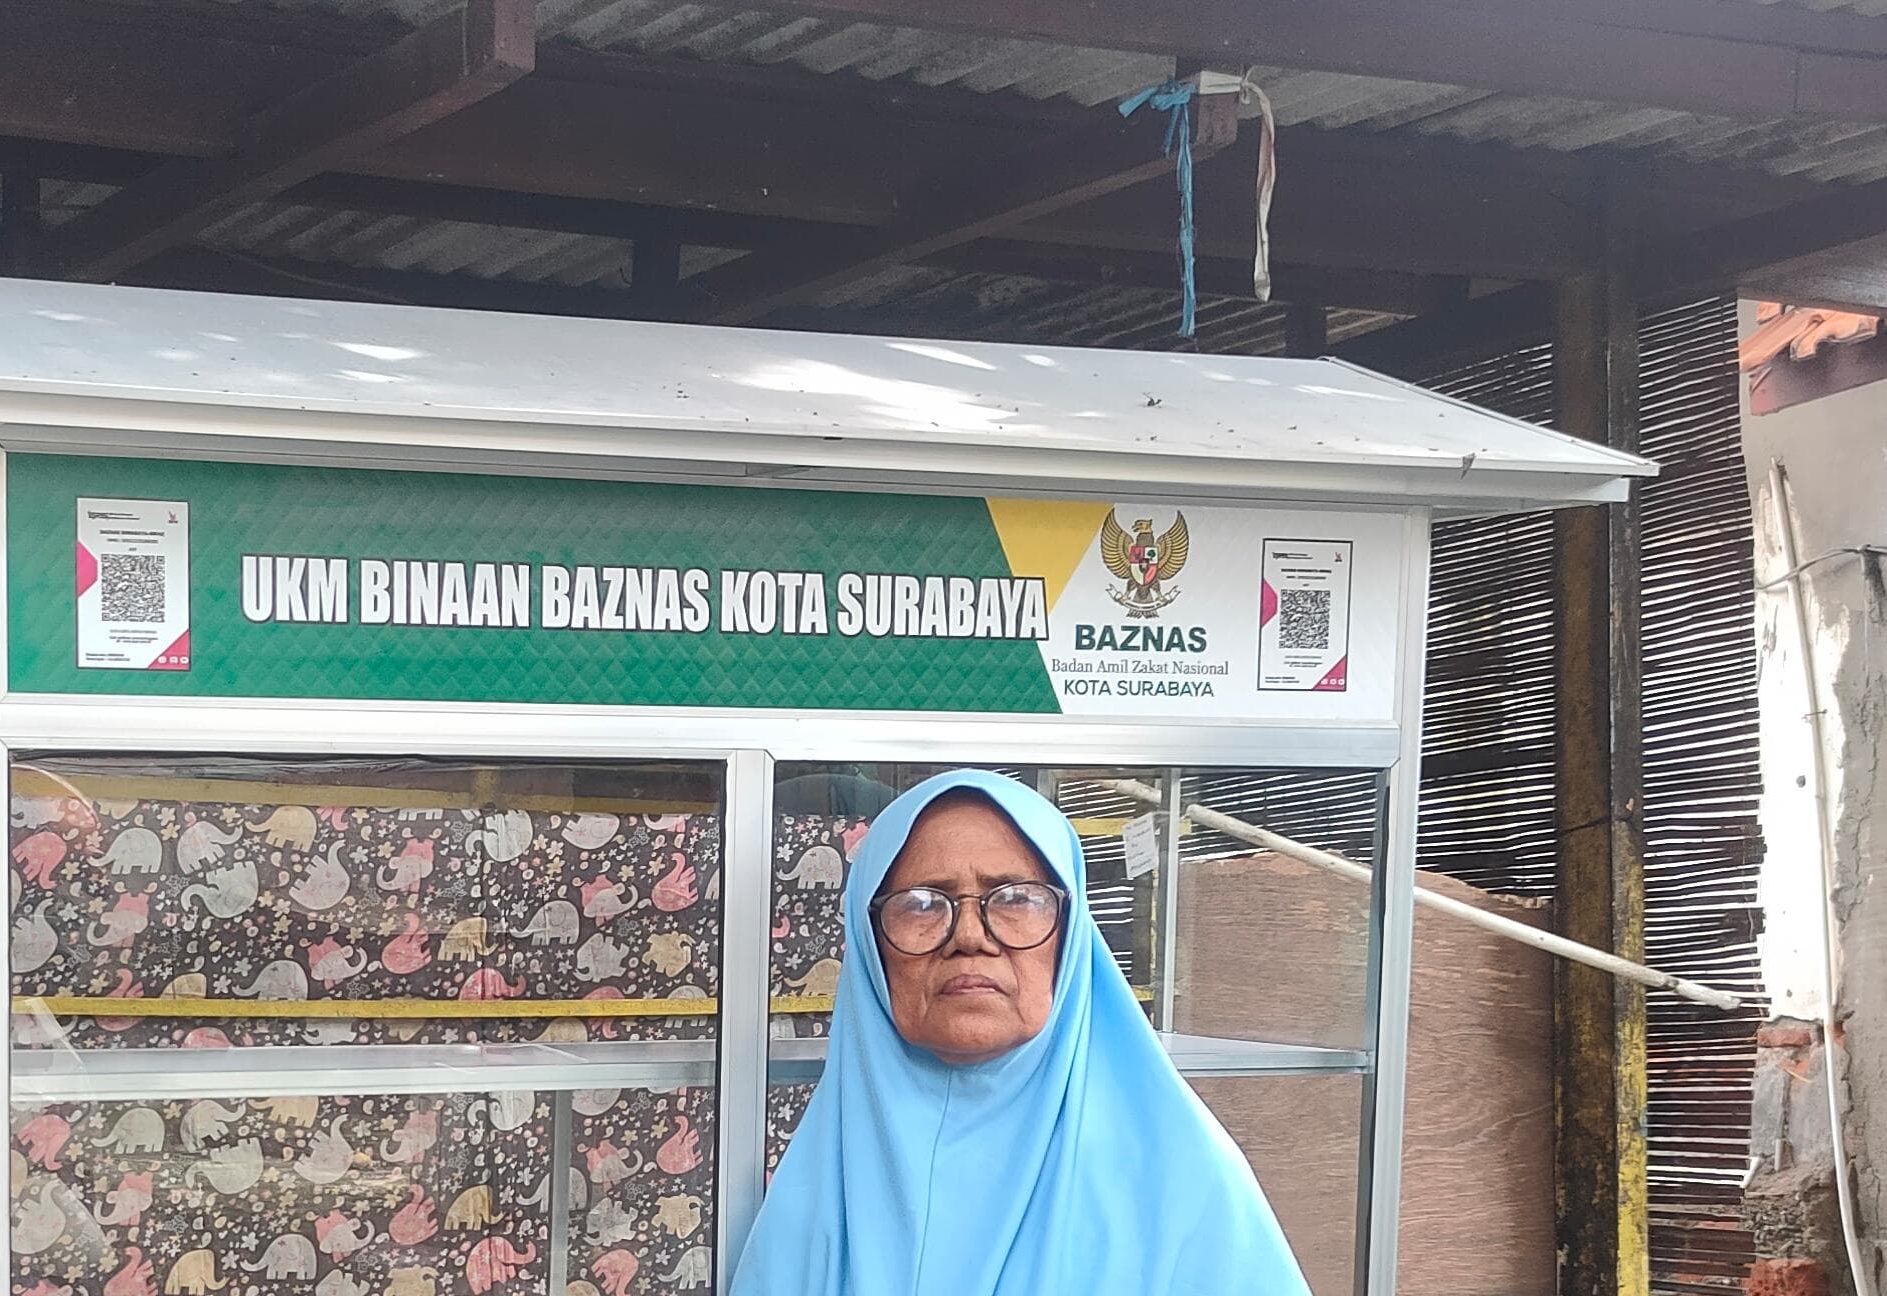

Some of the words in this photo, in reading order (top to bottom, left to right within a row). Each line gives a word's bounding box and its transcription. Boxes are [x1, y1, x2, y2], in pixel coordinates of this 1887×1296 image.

[240, 554, 349, 624] UKM
[360, 558, 531, 628] BINAAN
[541, 564, 713, 632] BAZNAS
[719, 569, 830, 636] KOTA
[835, 572, 1048, 641] SURABAYA
[1075, 624, 1207, 653] BAZNAS
[1052, 659, 1093, 673] Badan
[1097, 660, 1128, 673] Amil
[1132, 661, 1169, 675] Zakat
[1172, 661, 1229, 676] Nasional
[1064, 679, 1112, 696] KOTA
[1116, 681, 1215, 698] SURABAYA
